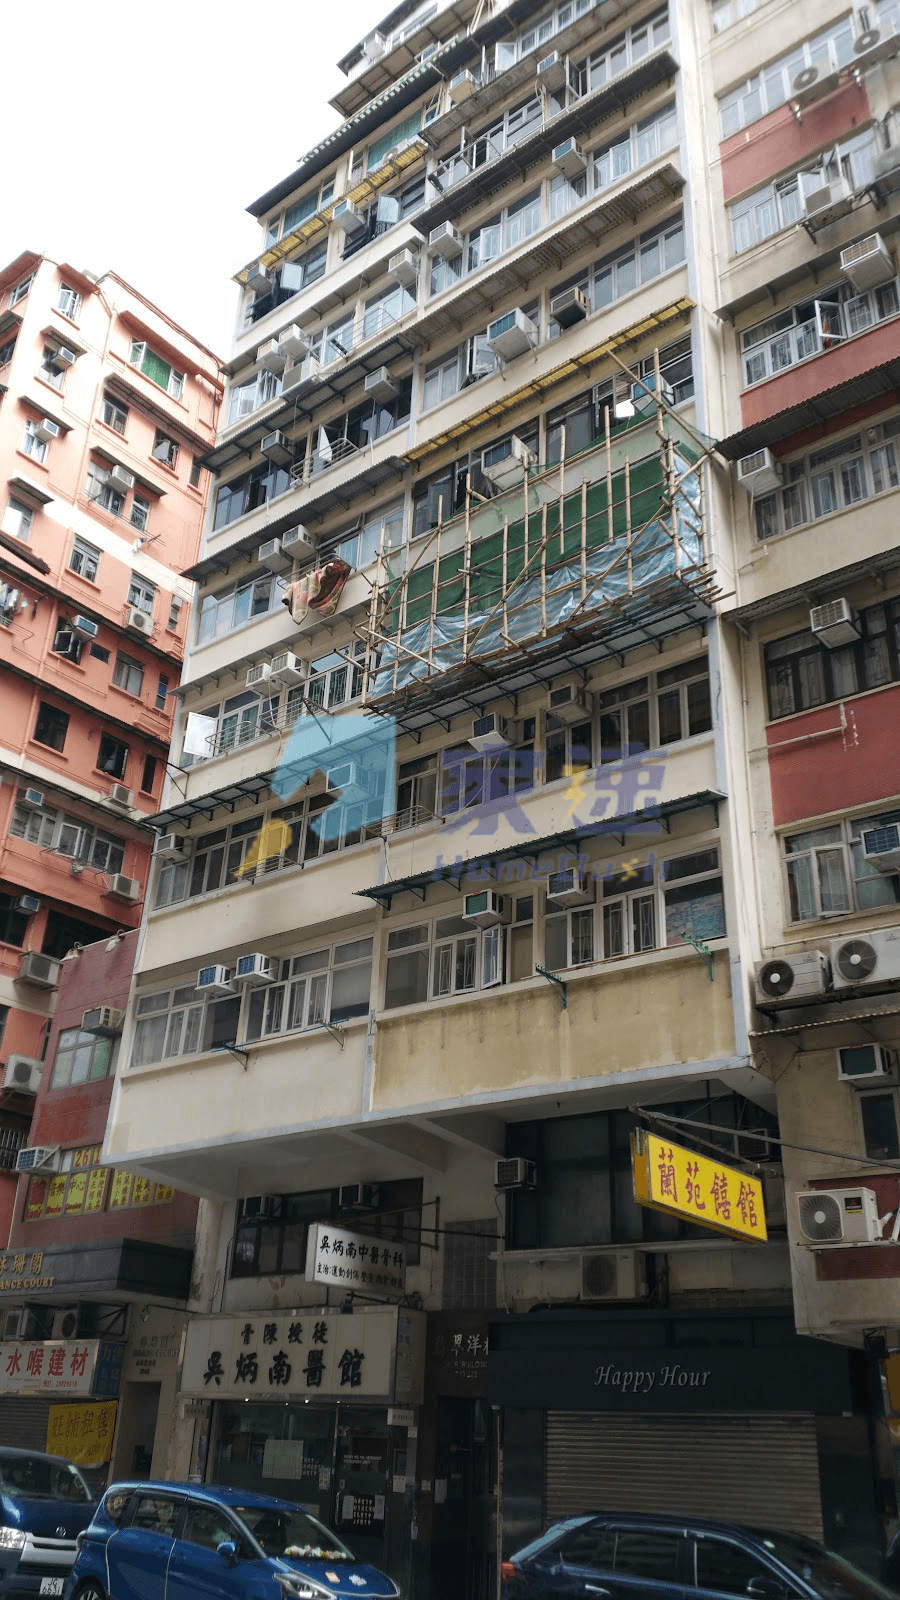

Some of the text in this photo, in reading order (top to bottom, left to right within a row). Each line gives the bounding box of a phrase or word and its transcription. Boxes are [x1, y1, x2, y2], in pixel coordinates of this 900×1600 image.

[320, 1236, 403, 1269] 吳炳南中醫骨科
[23, 1276, 55, 1290] COURT
[0, 1347, 89, 1376] 水喉建材
[203, 1348, 365, 1388] 吳炳南醫館
[594, 1365, 711, 1393] Happy Hour
